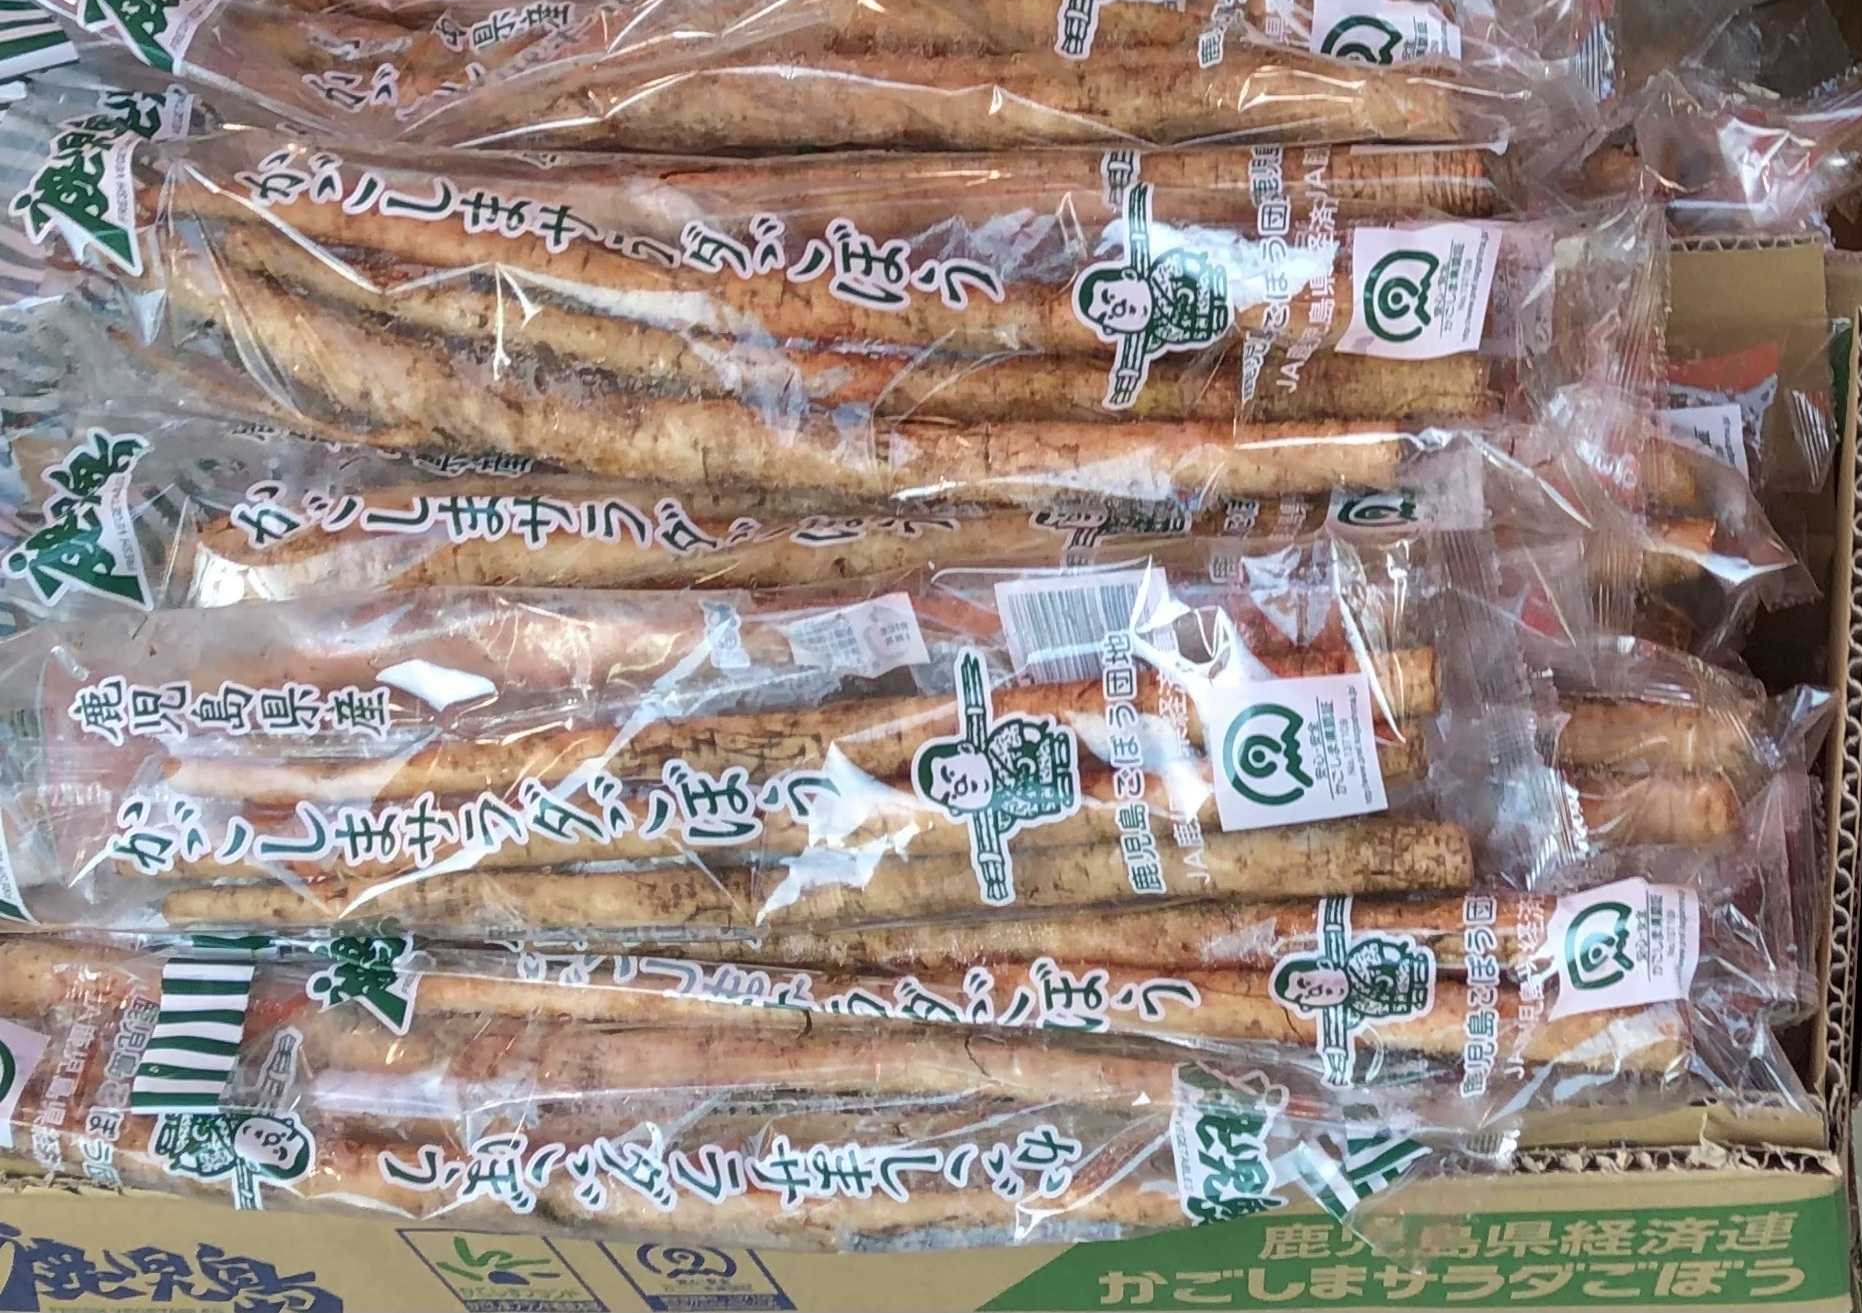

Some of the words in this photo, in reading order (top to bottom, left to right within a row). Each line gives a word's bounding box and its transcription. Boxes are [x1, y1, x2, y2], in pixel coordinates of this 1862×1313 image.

[234, 145, 1002, 310] かごしまサラダごぼう
[69, 680, 391, 744] 鹿児島県産
[1101, 628, 1168, 895] 鹿児島ごぼう団地
[1099, 1260, 1808, 1307] かごしまサラダごぼう
